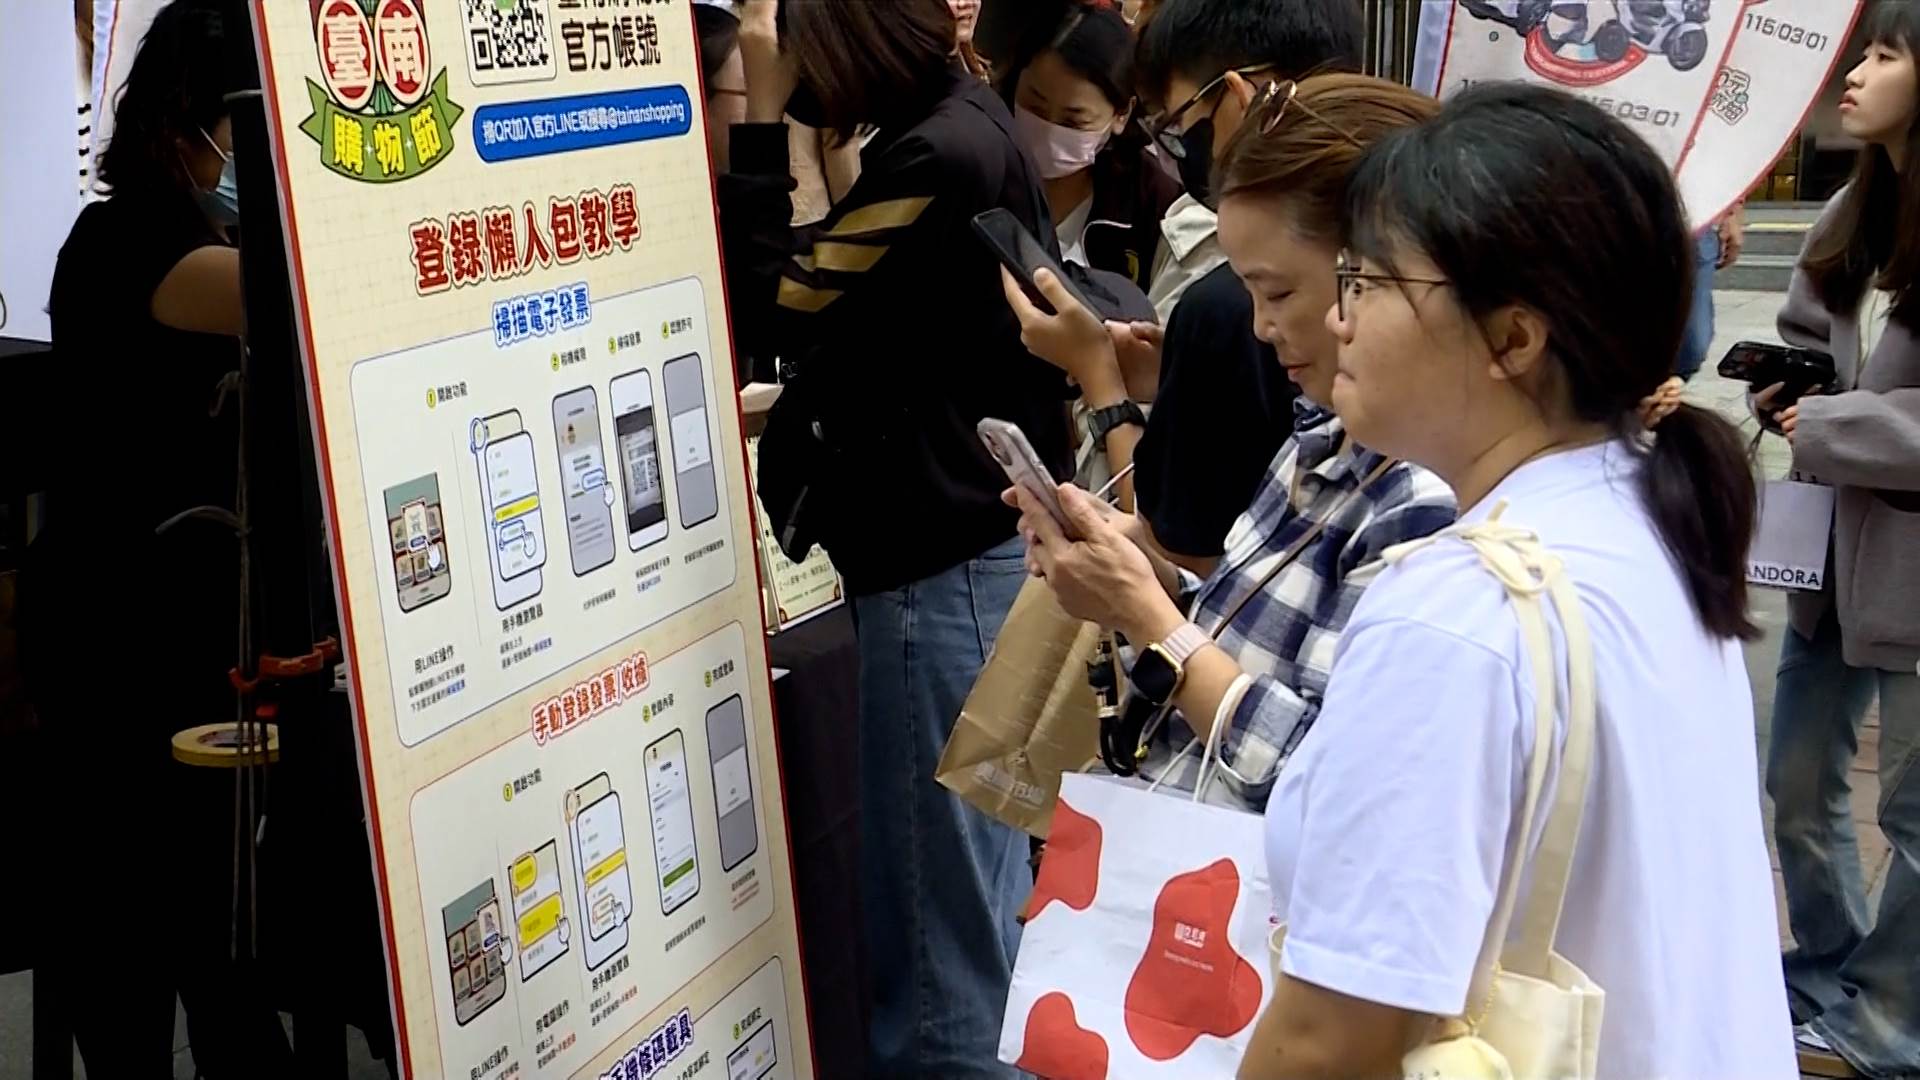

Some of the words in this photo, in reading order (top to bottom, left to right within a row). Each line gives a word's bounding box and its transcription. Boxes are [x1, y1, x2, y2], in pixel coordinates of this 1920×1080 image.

[561, 14, 661, 72] 官方帳號
[333, 104, 442, 176] 購物節
[412, 186, 640, 292] 登錄懶人包教學
[495, 286, 590, 343] 掃描電子發票
[534, 656, 648, 741] 手動登錄發票/收據
